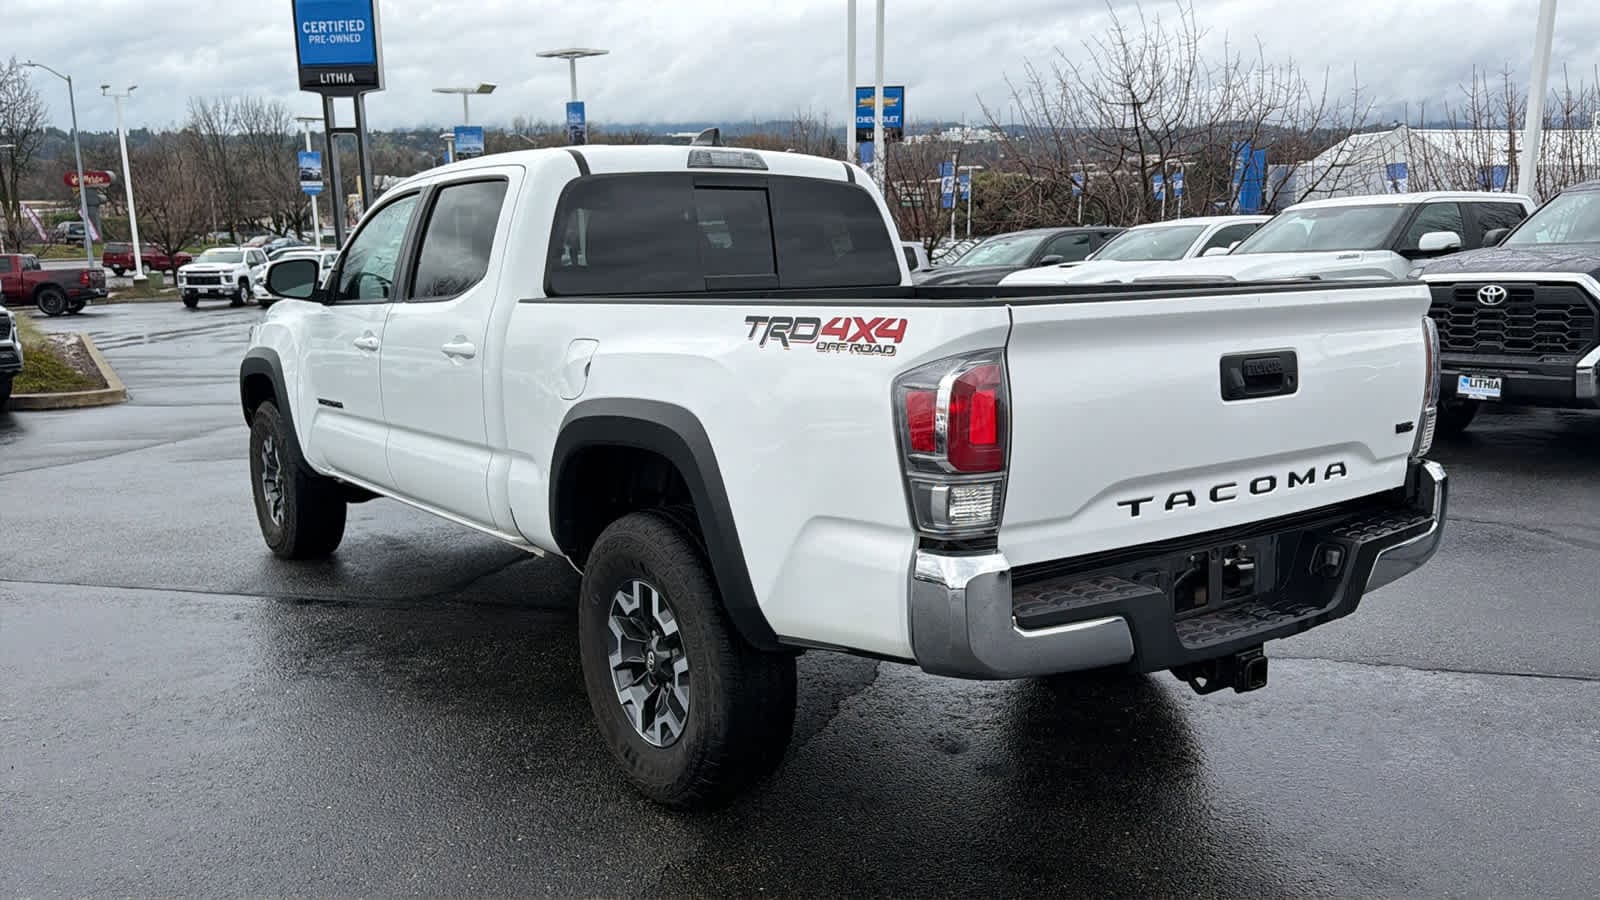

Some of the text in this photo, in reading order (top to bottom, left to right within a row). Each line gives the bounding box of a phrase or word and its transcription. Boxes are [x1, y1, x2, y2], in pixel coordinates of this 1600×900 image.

[302, 20, 366, 34] CERTIFIED
[308, 33, 361, 44] PRE-OWNED
[319, 73, 355, 84] LITHIA
[816, 342, 896, 356] OFF ROAD
[1469, 378, 1500, 390] LITHIA
[1117, 461, 1348, 517] TACOMA
